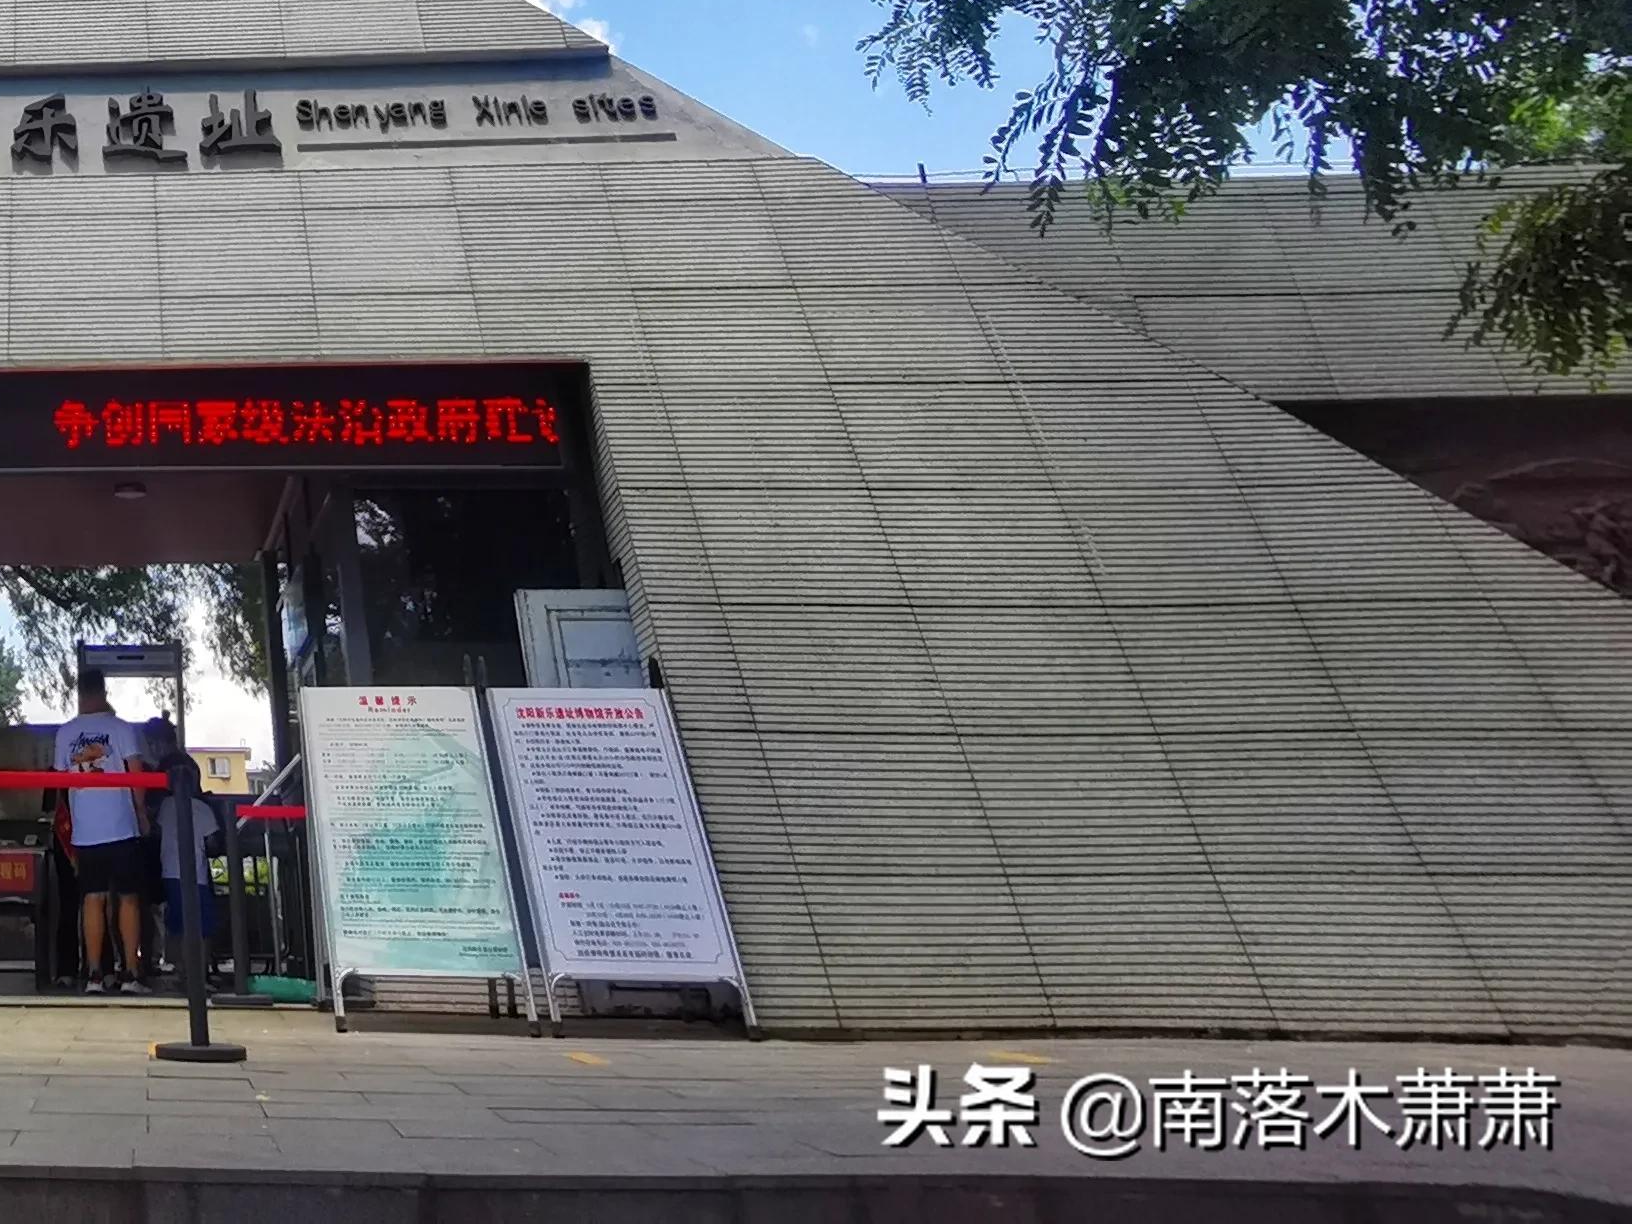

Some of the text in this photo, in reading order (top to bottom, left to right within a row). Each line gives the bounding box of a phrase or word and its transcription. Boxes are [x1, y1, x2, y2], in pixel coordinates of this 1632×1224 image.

[296, 98, 447, 134] Shenyang
[472, 93, 549, 127] Xinle
[515, 706, 645, 720] 沈阳新乐遗址博物馆开放公告
